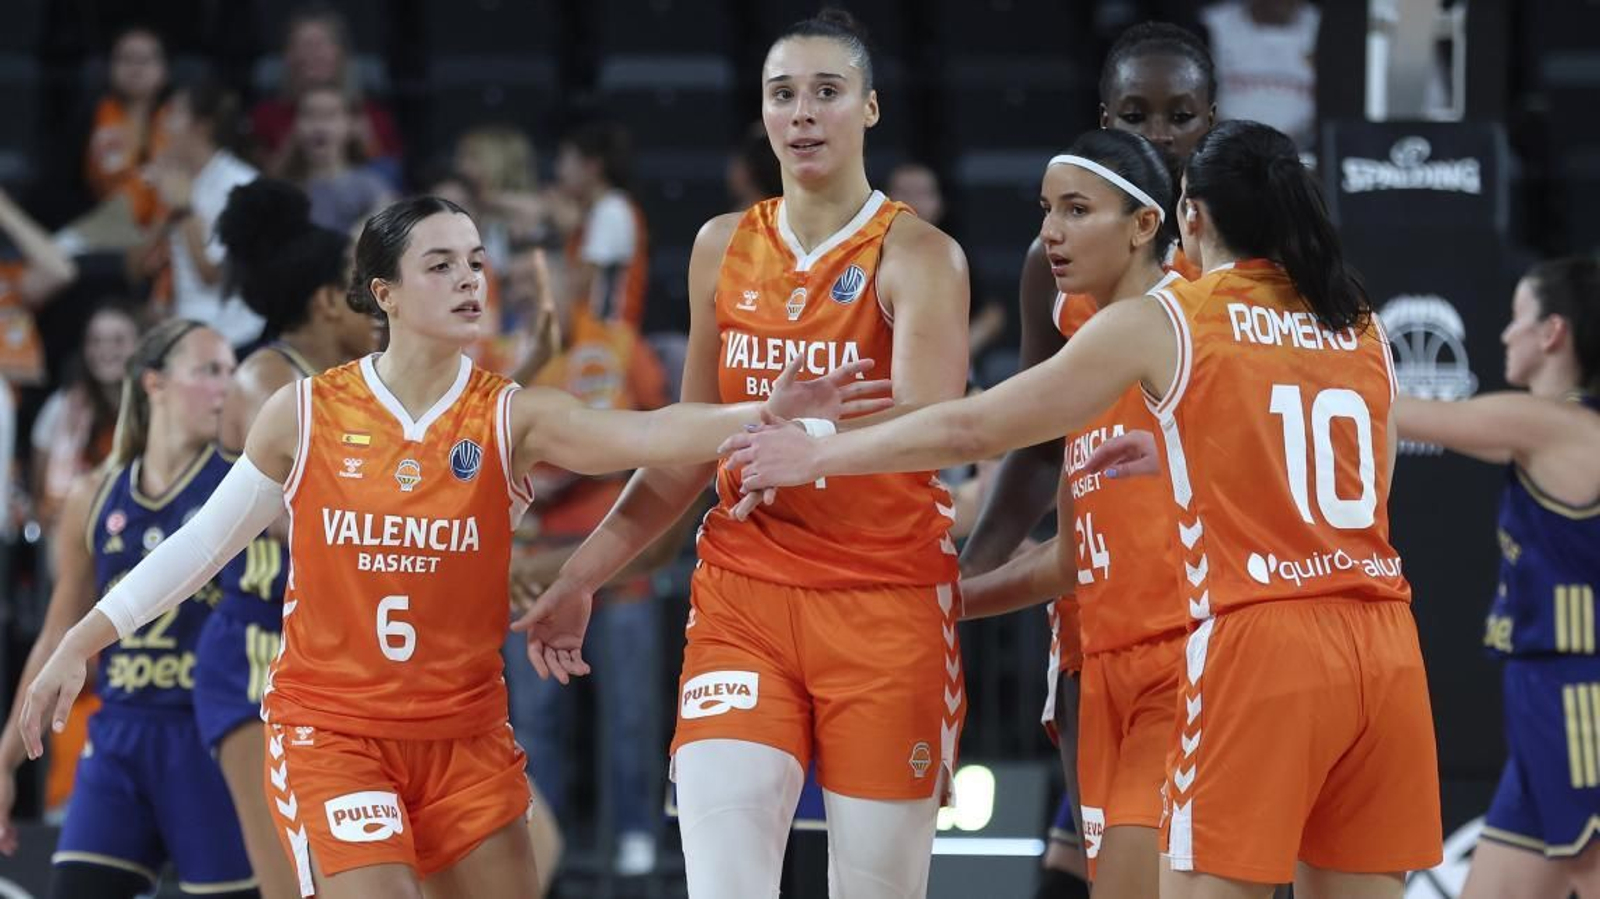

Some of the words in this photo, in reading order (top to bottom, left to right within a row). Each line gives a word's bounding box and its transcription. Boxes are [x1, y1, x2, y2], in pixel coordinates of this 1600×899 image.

[1269, 384, 1377, 529] 10
[322, 507, 479, 552] VALENCIA
[358, 553, 440, 573] BASKET
[376, 595, 417, 662] 6
[684, 683, 752, 706] PULEVA
[333, 804, 398, 826] PULEVA
